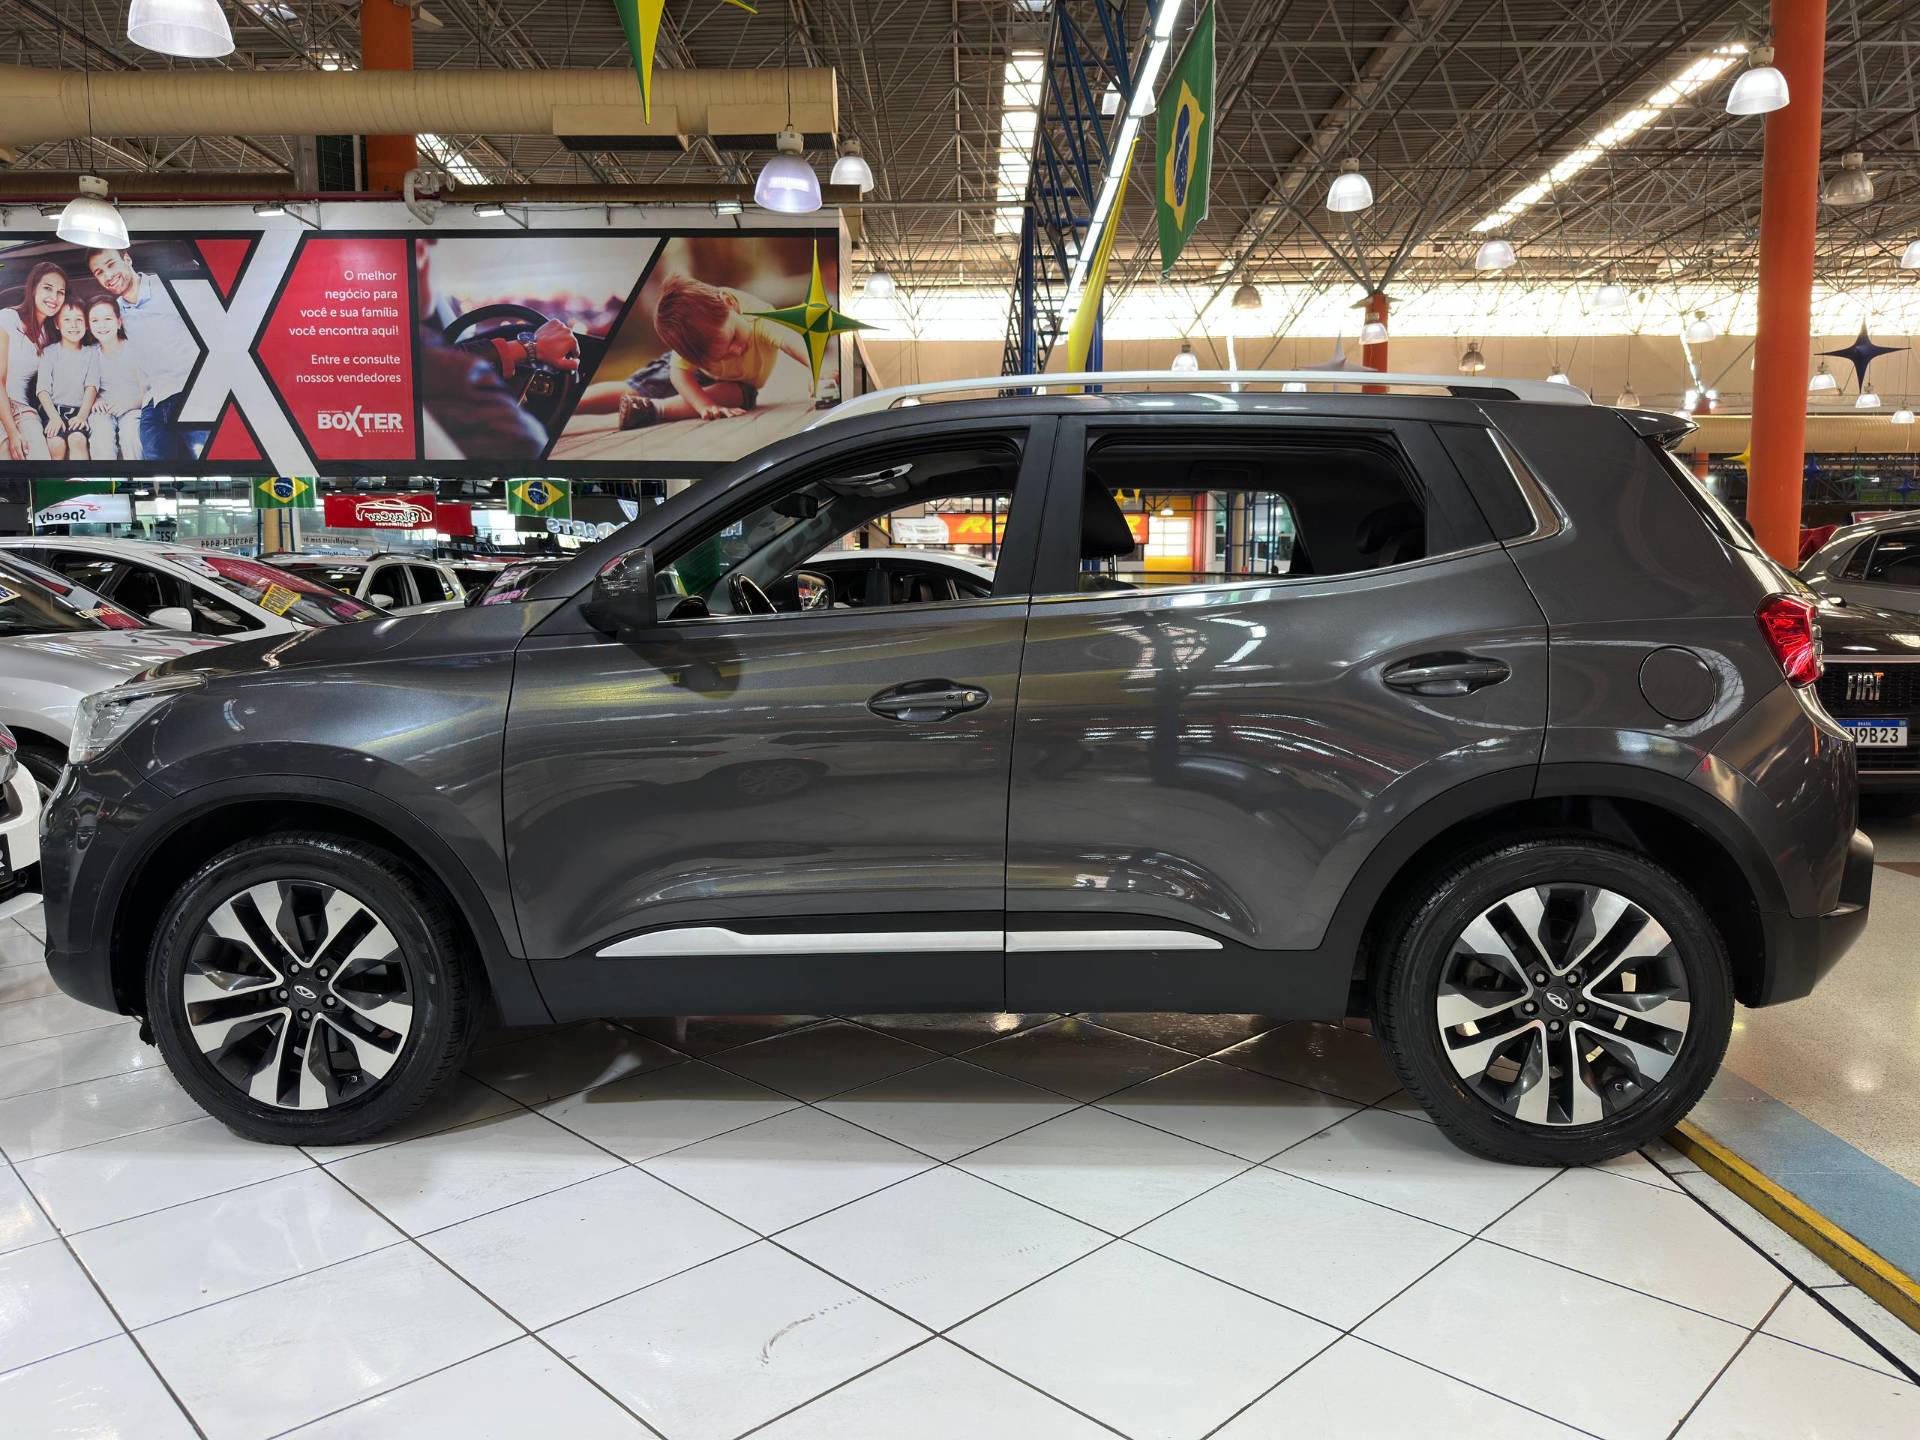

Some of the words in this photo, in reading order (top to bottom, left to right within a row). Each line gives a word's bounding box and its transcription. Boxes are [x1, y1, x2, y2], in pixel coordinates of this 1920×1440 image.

[344, 271, 354, 281] O
[357, 270, 397, 281] melhor
[325, 289, 371, 302] negócio
[374, 291, 398, 301] para
[300, 307, 327, 318] você
[330, 310, 337, 318] e
[340, 310, 359, 318] sua
[362, 307, 399, 318] família
[289, 326, 316, 336] você
[319, 327, 369, 336] encontra
[372, 326, 399, 338] aqui!
[311, 354, 340, 364] Entre
[353, 354, 401, 364] consulte
[296, 374, 334, 383] nossos
[337, 372, 402, 383] vendedores
[317, 405, 403, 437] BOXTER
[1846, 672, 1884, 701] FIAT
